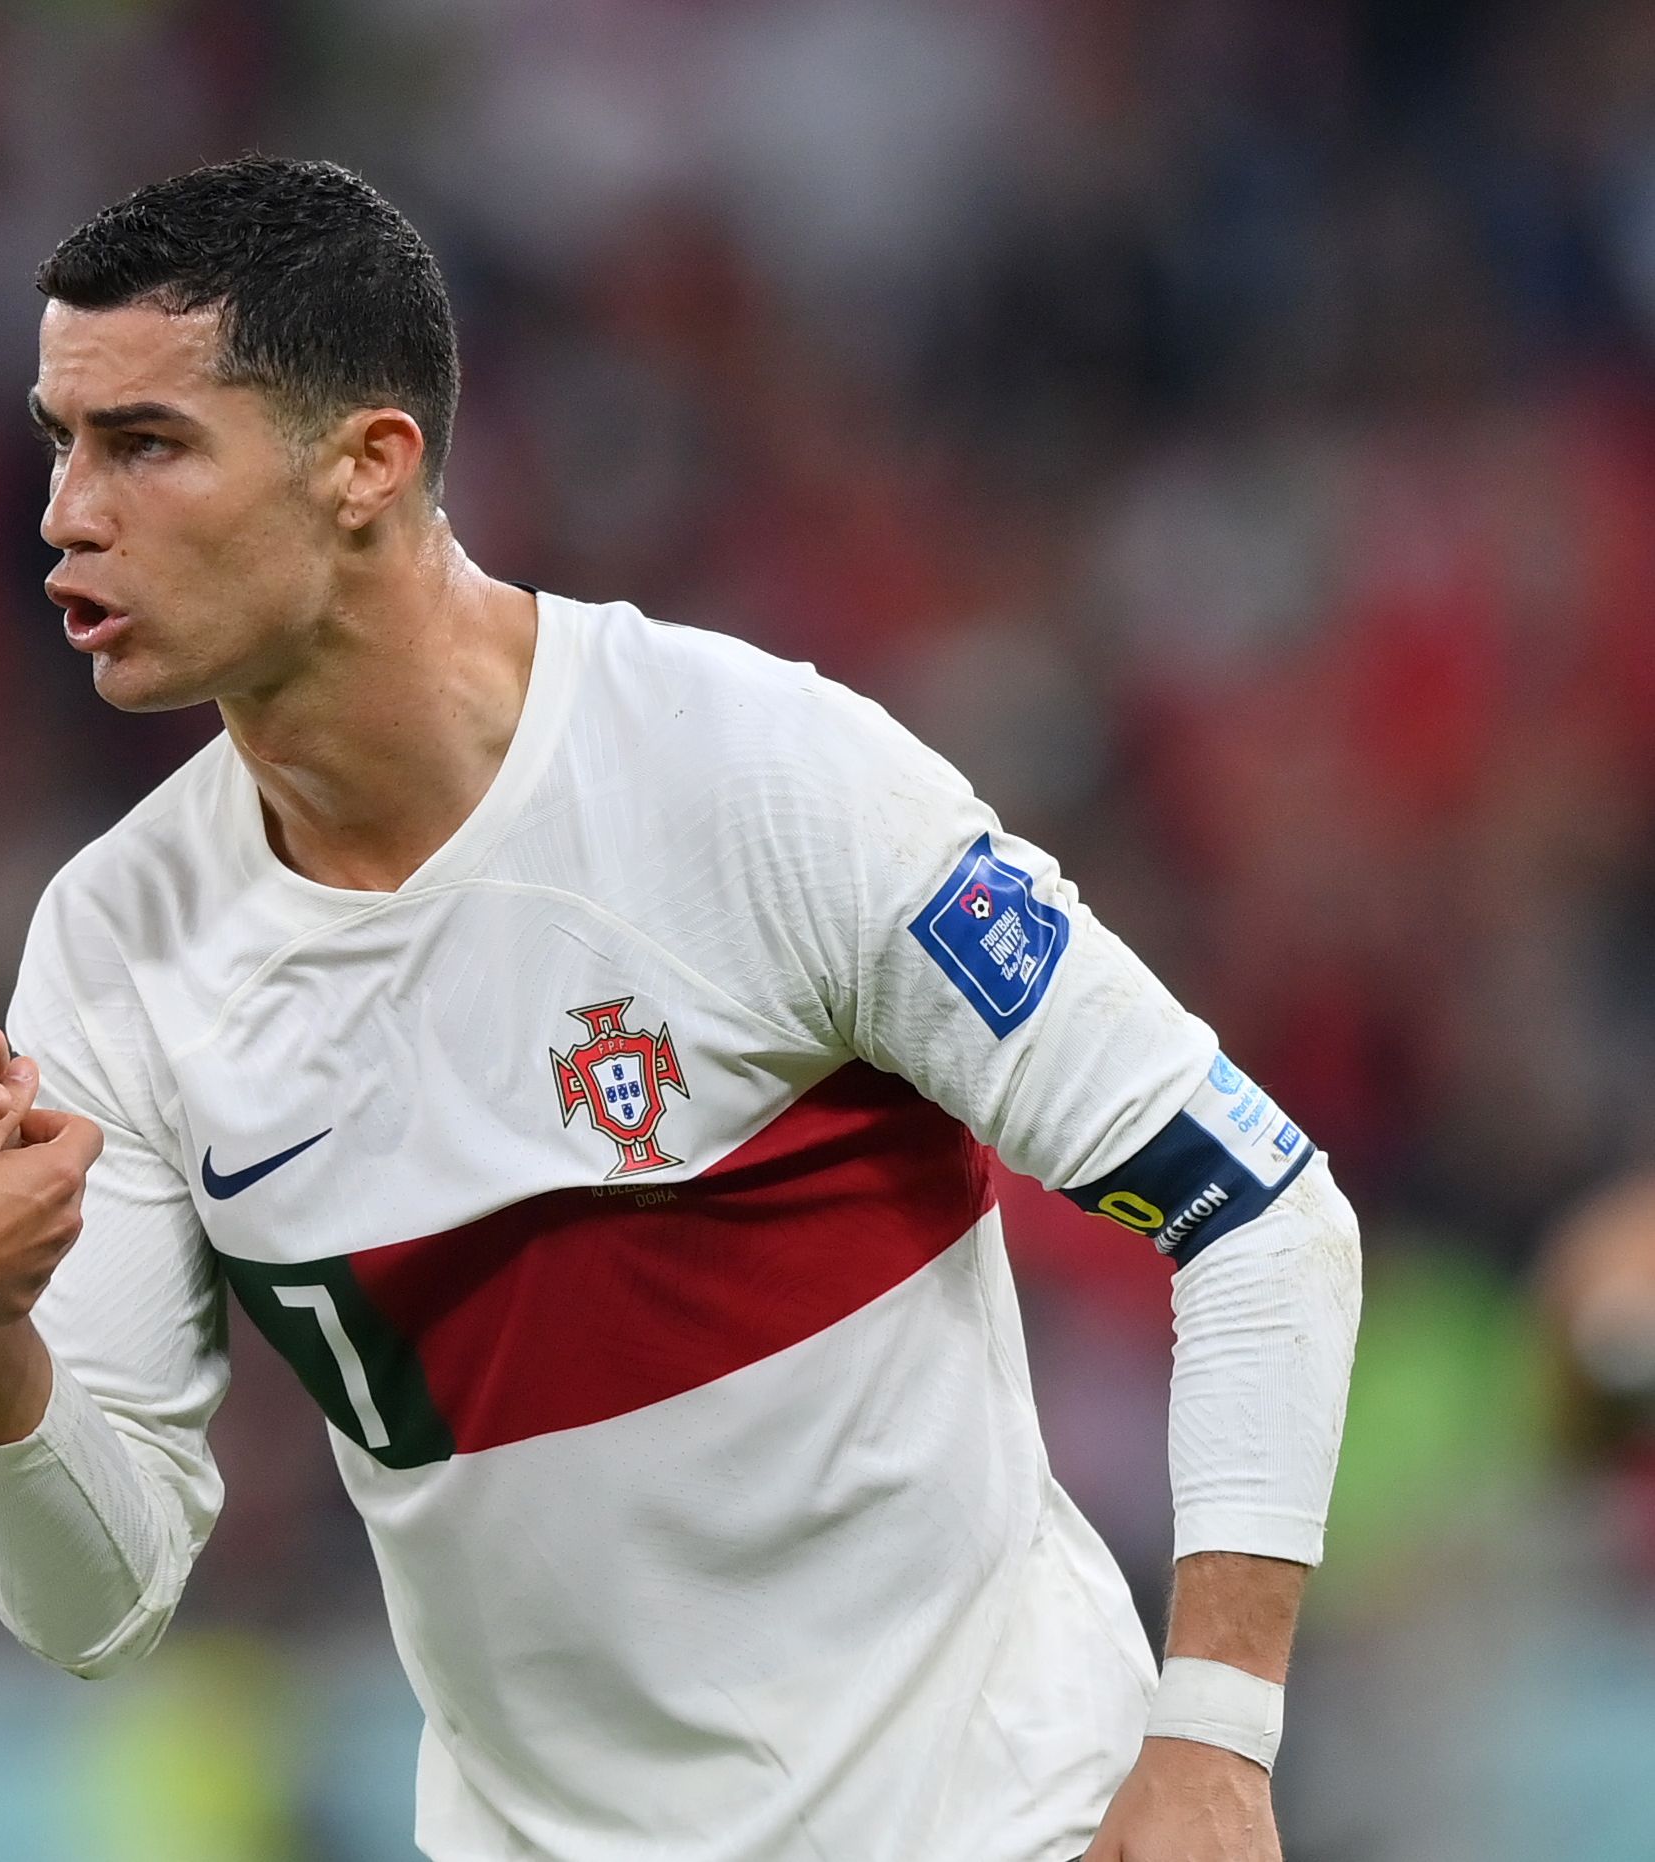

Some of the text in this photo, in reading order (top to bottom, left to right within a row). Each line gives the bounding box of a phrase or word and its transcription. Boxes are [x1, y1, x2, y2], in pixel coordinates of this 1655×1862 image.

[979, 906, 1018, 951] FOOTBALL
[1227, 1092, 1253, 1122] World
[1278, 1126, 1298, 1150] FIFA
[635, 1187, 678, 1208] DOHA
[271, 1284, 391, 1449] 7
